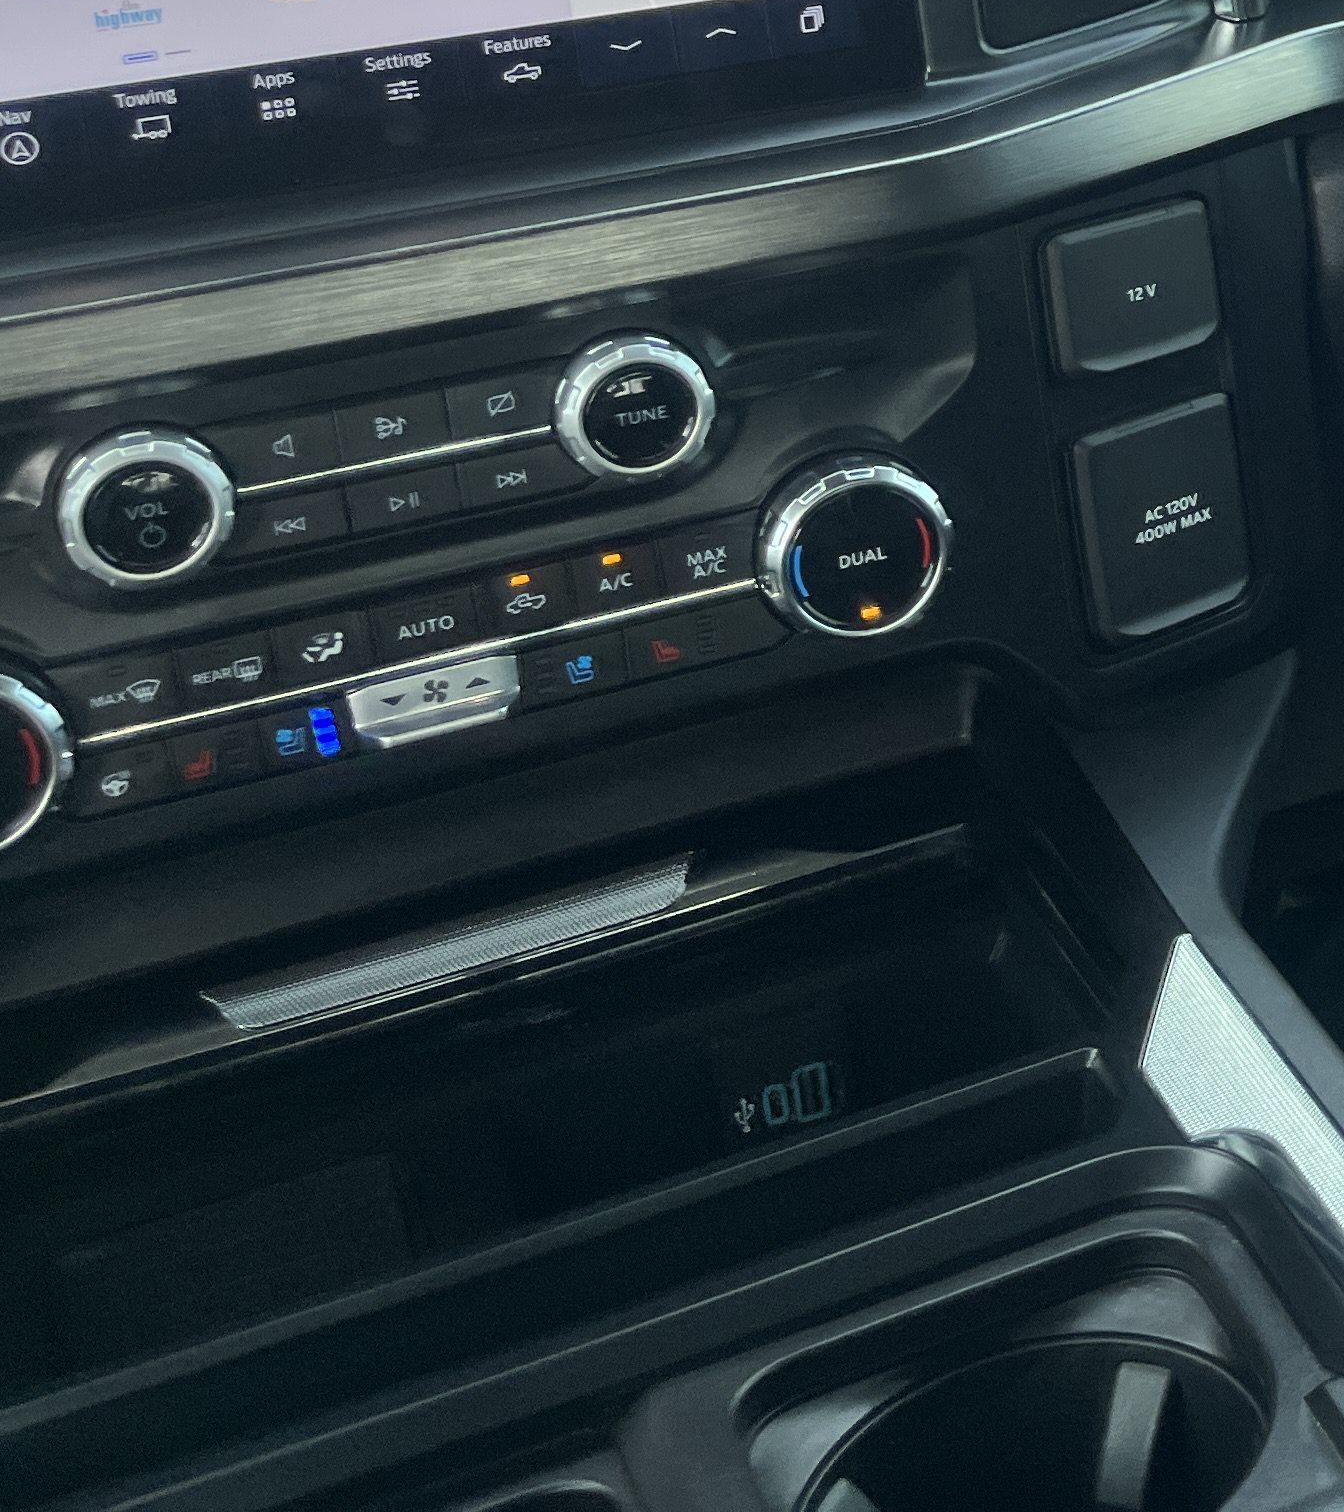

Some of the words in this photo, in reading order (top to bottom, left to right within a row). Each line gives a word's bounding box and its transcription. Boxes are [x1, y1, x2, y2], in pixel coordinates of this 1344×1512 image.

[94, 7, 163, 30] highway
[483, 33, 552, 55] Features
[364, 49, 432, 73] Settings
[252, 70, 295, 90] Apps
[112, 88, 178, 110] Towing
[0, 108, 32, 126] Nav
[615, 404, 671, 427] TUNE
[123, 501, 169, 521] VOL
[1144, 505, 1164, 524] AC
[1165, 492, 1198, 516] 120V
[1135, 519, 1178, 545] 400W
[1180, 506, 1212, 529] MAX
[686, 545, 727, 568] MAX
[838, 546, 888, 570] DUAL
[693, 558, 727, 580] A/C
[599, 571, 634, 593] A/C
[398, 614, 456, 641] AUTO
